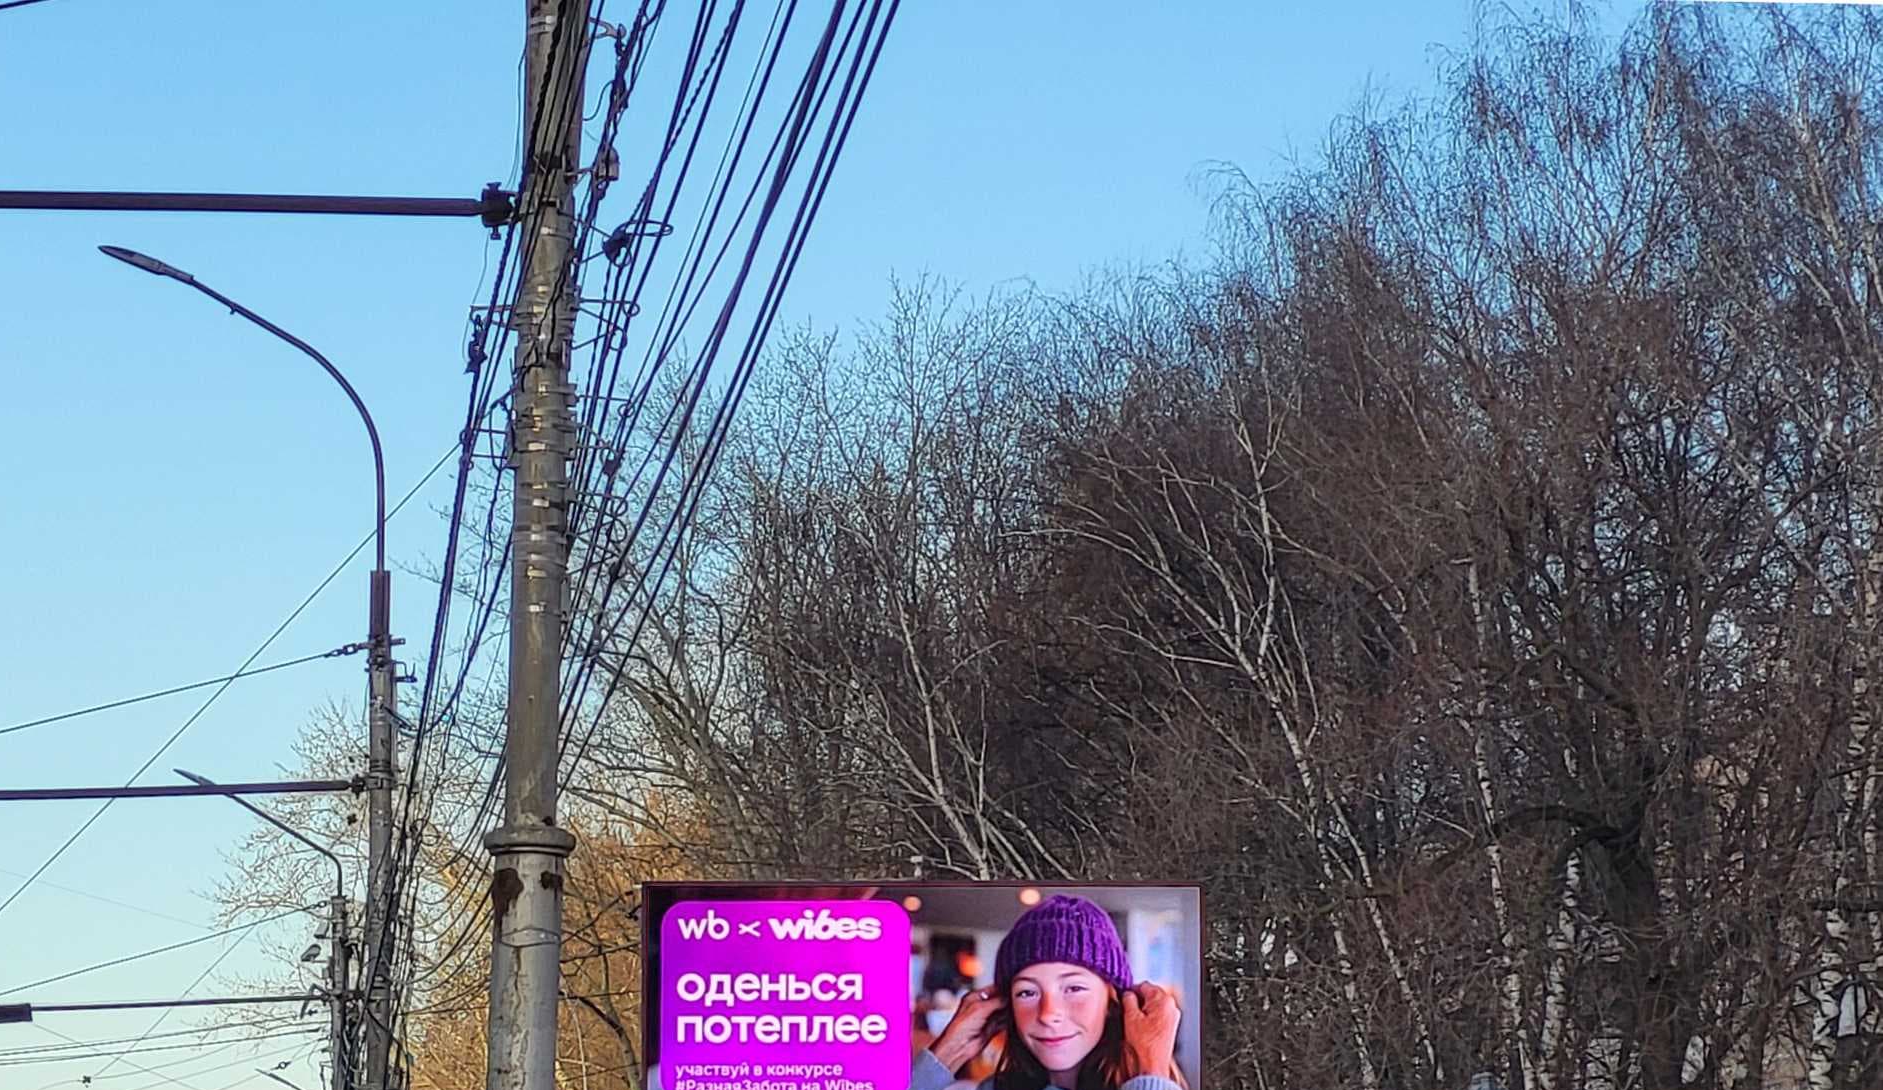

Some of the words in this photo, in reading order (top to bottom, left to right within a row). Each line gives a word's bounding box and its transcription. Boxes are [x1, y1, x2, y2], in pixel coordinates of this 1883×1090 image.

[677, 909, 731, 941] wb
[767, 908, 883, 941] wibes
[675, 971, 864, 1008] оденься
[675, 1013, 889, 1044] потеплее
[674, 1062, 750, 1079] участвуй
[752, 1065, 764, 1077] в
[767, 1064, 844, 1079] конкурсе
